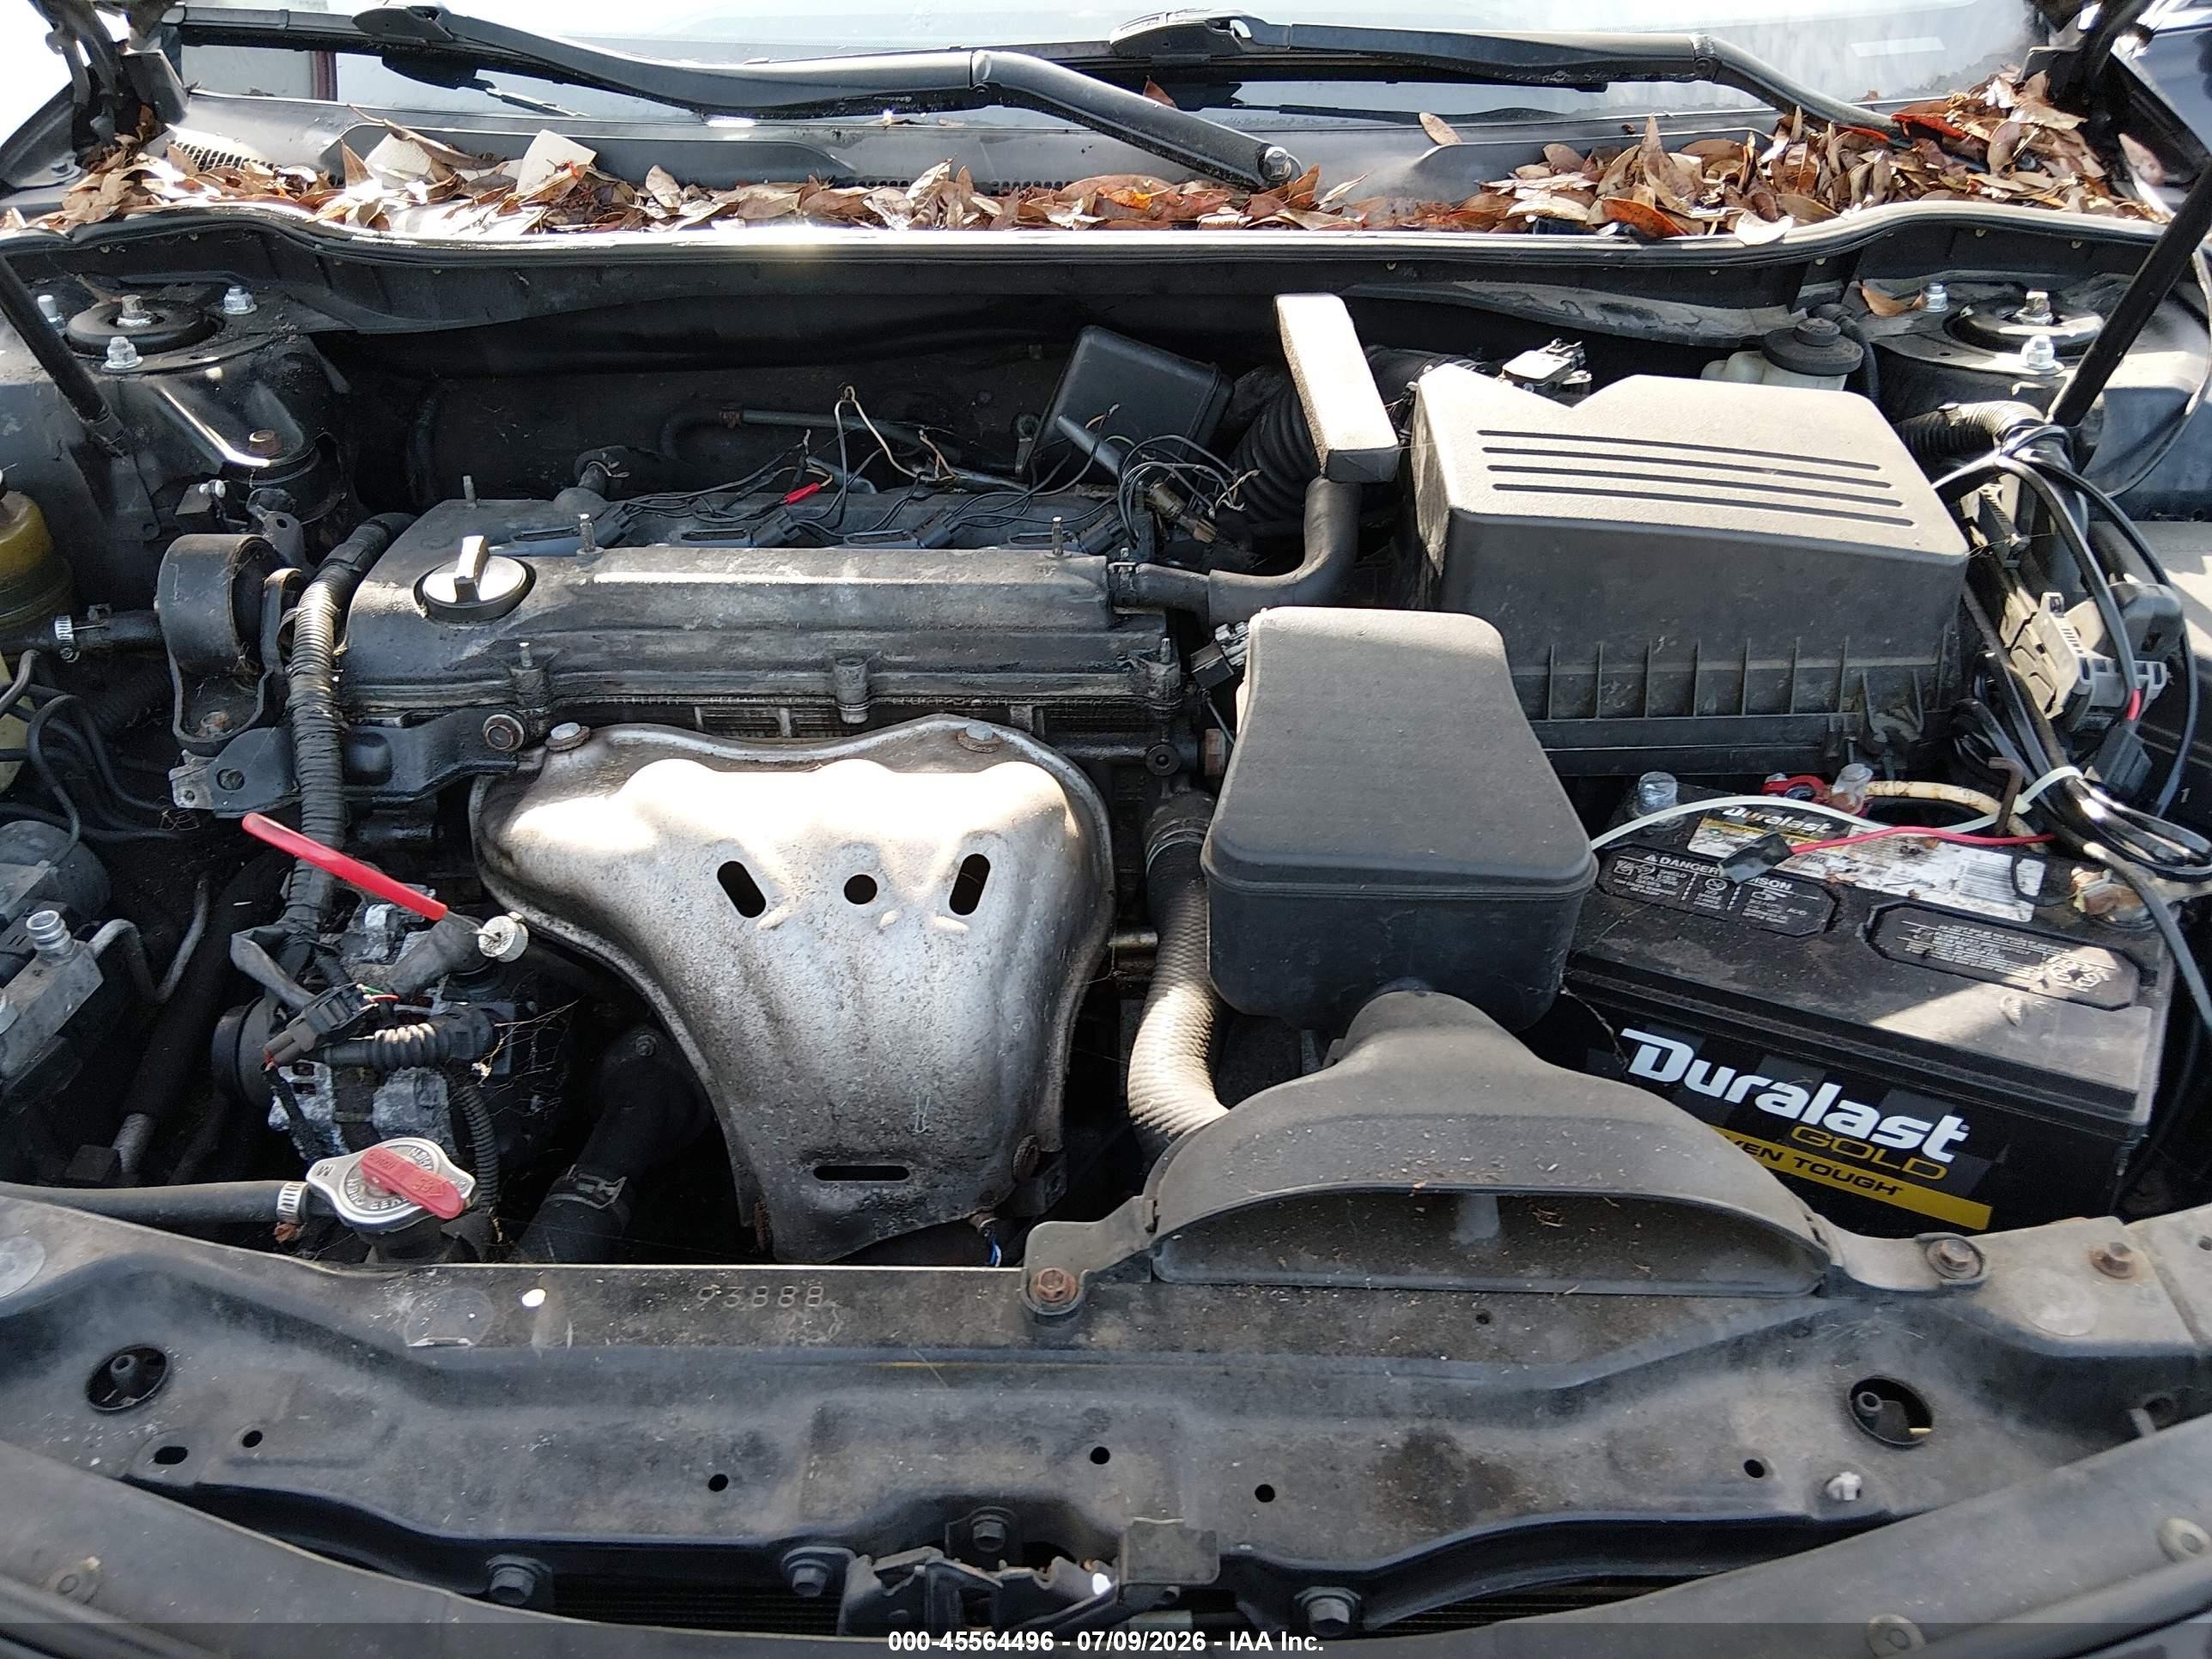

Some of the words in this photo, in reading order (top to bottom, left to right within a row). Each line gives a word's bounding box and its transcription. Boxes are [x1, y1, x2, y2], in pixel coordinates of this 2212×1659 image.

[1722, 806, 1833, 834] Duralast
[1659, 856, 1719, 875] DANGER
[1747, 877, 1793, 891] ISON
[1621, 1027, 1969, 1163] Duralast
[1790, 1124, 1948, 1182] GOLD
[1793, 1156, 1899, 1196] TOUGH
